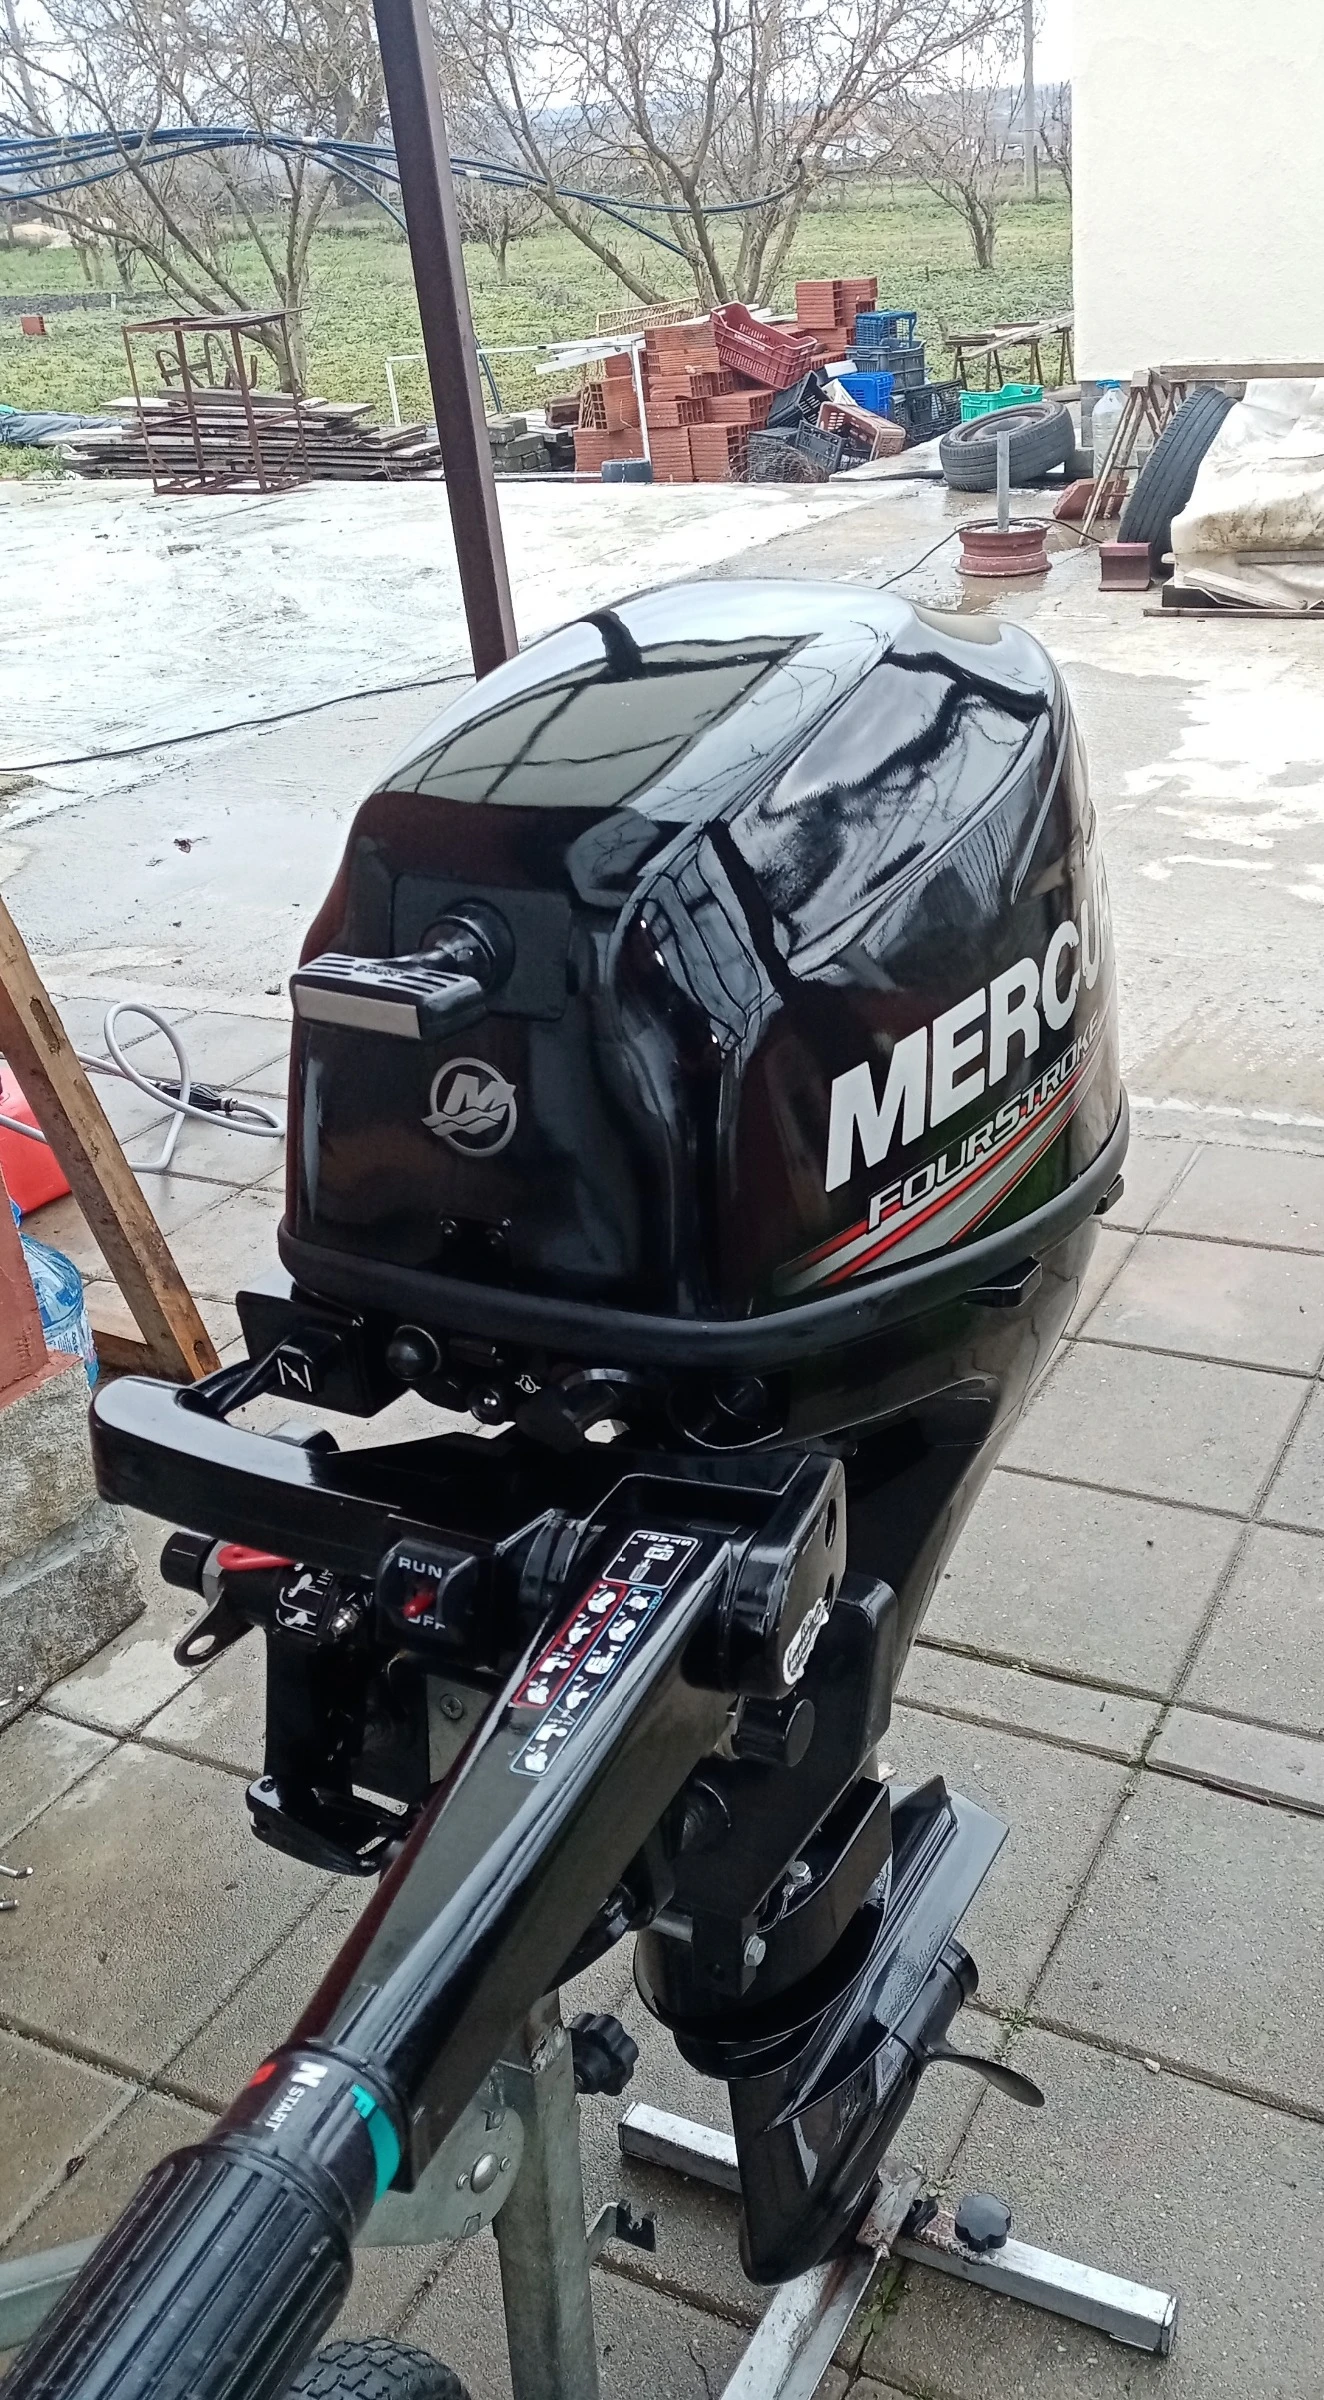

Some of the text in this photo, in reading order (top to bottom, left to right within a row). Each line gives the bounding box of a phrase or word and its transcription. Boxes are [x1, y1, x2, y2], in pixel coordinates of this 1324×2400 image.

[867, 1009, 1099, 1231] FOURSTROKE
[636, 1533, 693, 1547] START
[398, 1556, 443, 1579] RUN
[291, 2062, 328, 2088] N
[265, 2086, 306, 2132] START
